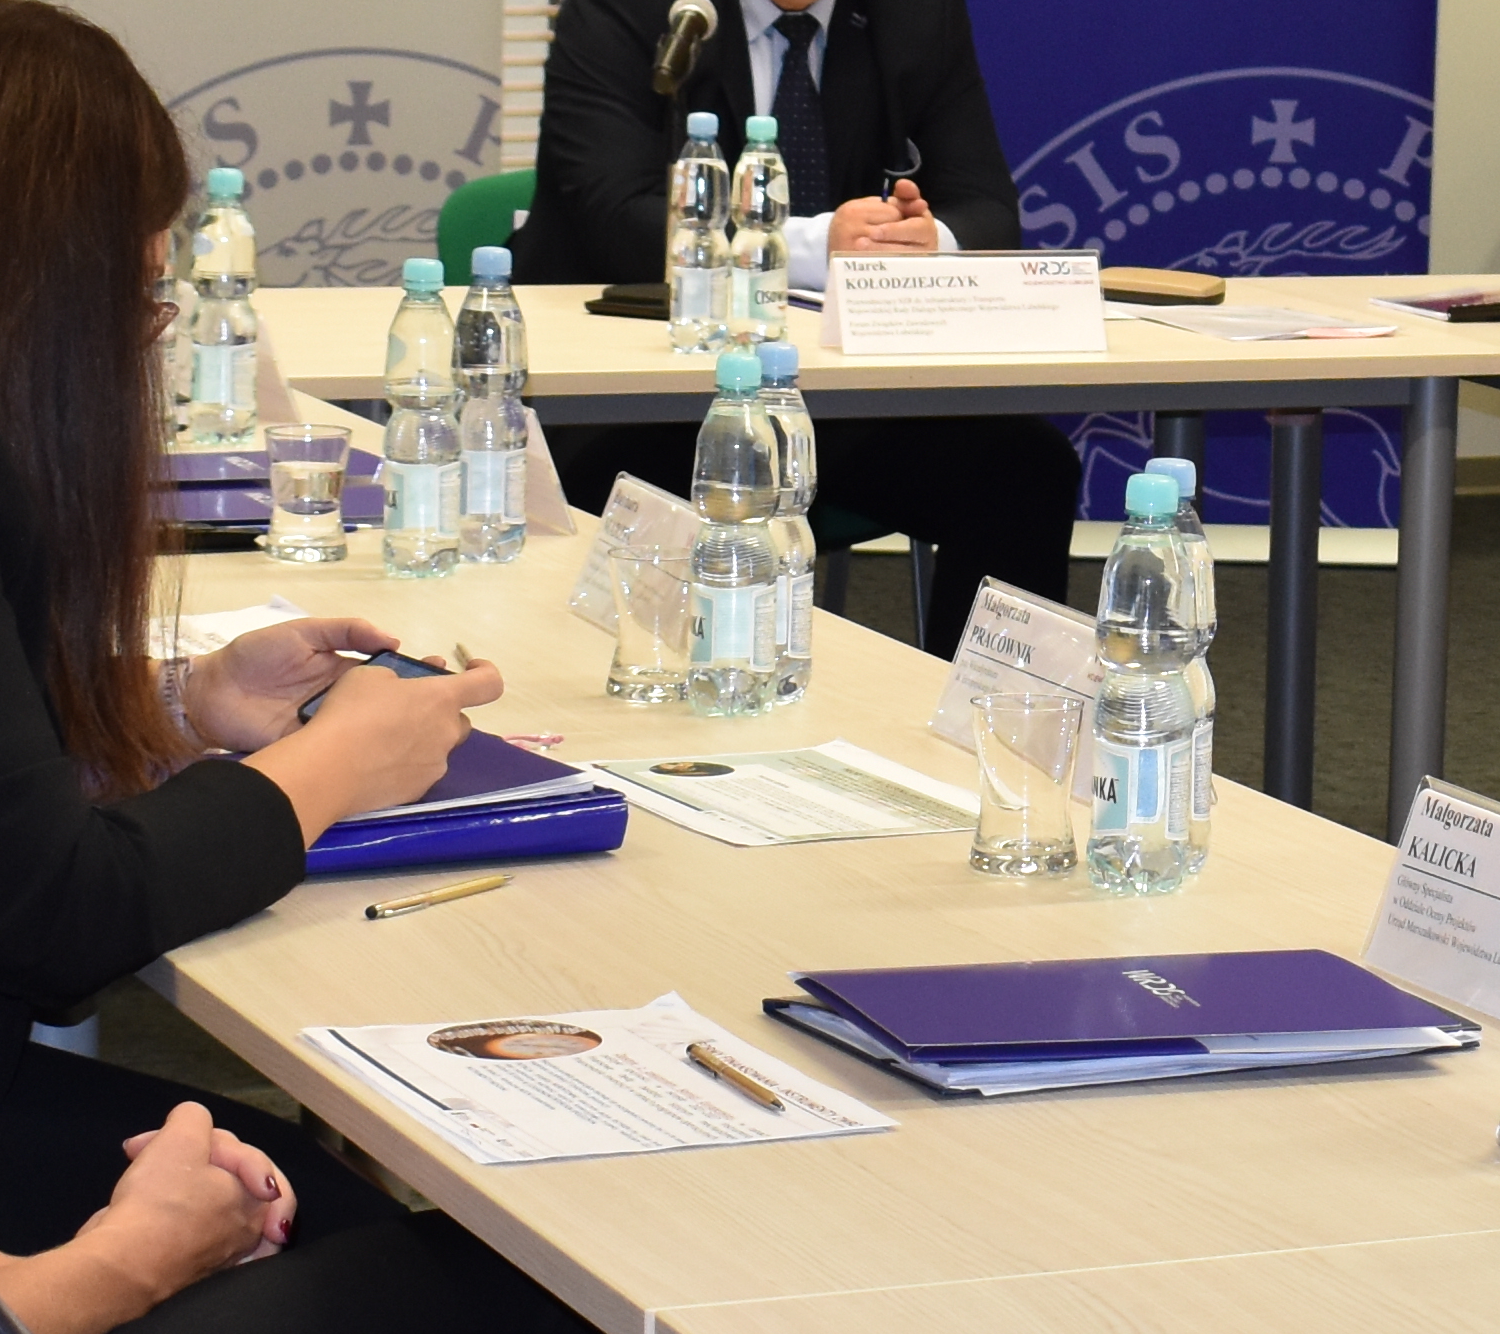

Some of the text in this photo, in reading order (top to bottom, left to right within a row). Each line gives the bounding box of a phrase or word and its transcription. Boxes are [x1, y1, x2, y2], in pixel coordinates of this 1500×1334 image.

[844, 259, 888, 272] Marek
[845, 275, 979, 290] KOŁODZIEJCZYK
[980, 592, 1031, 626] Małgorzata
[969, 624, 1036, 665] PRACOWNIK
[1421, 796, 1494, 838] Małgorzata
[1407, 835, 1477, 878] KALICKA
